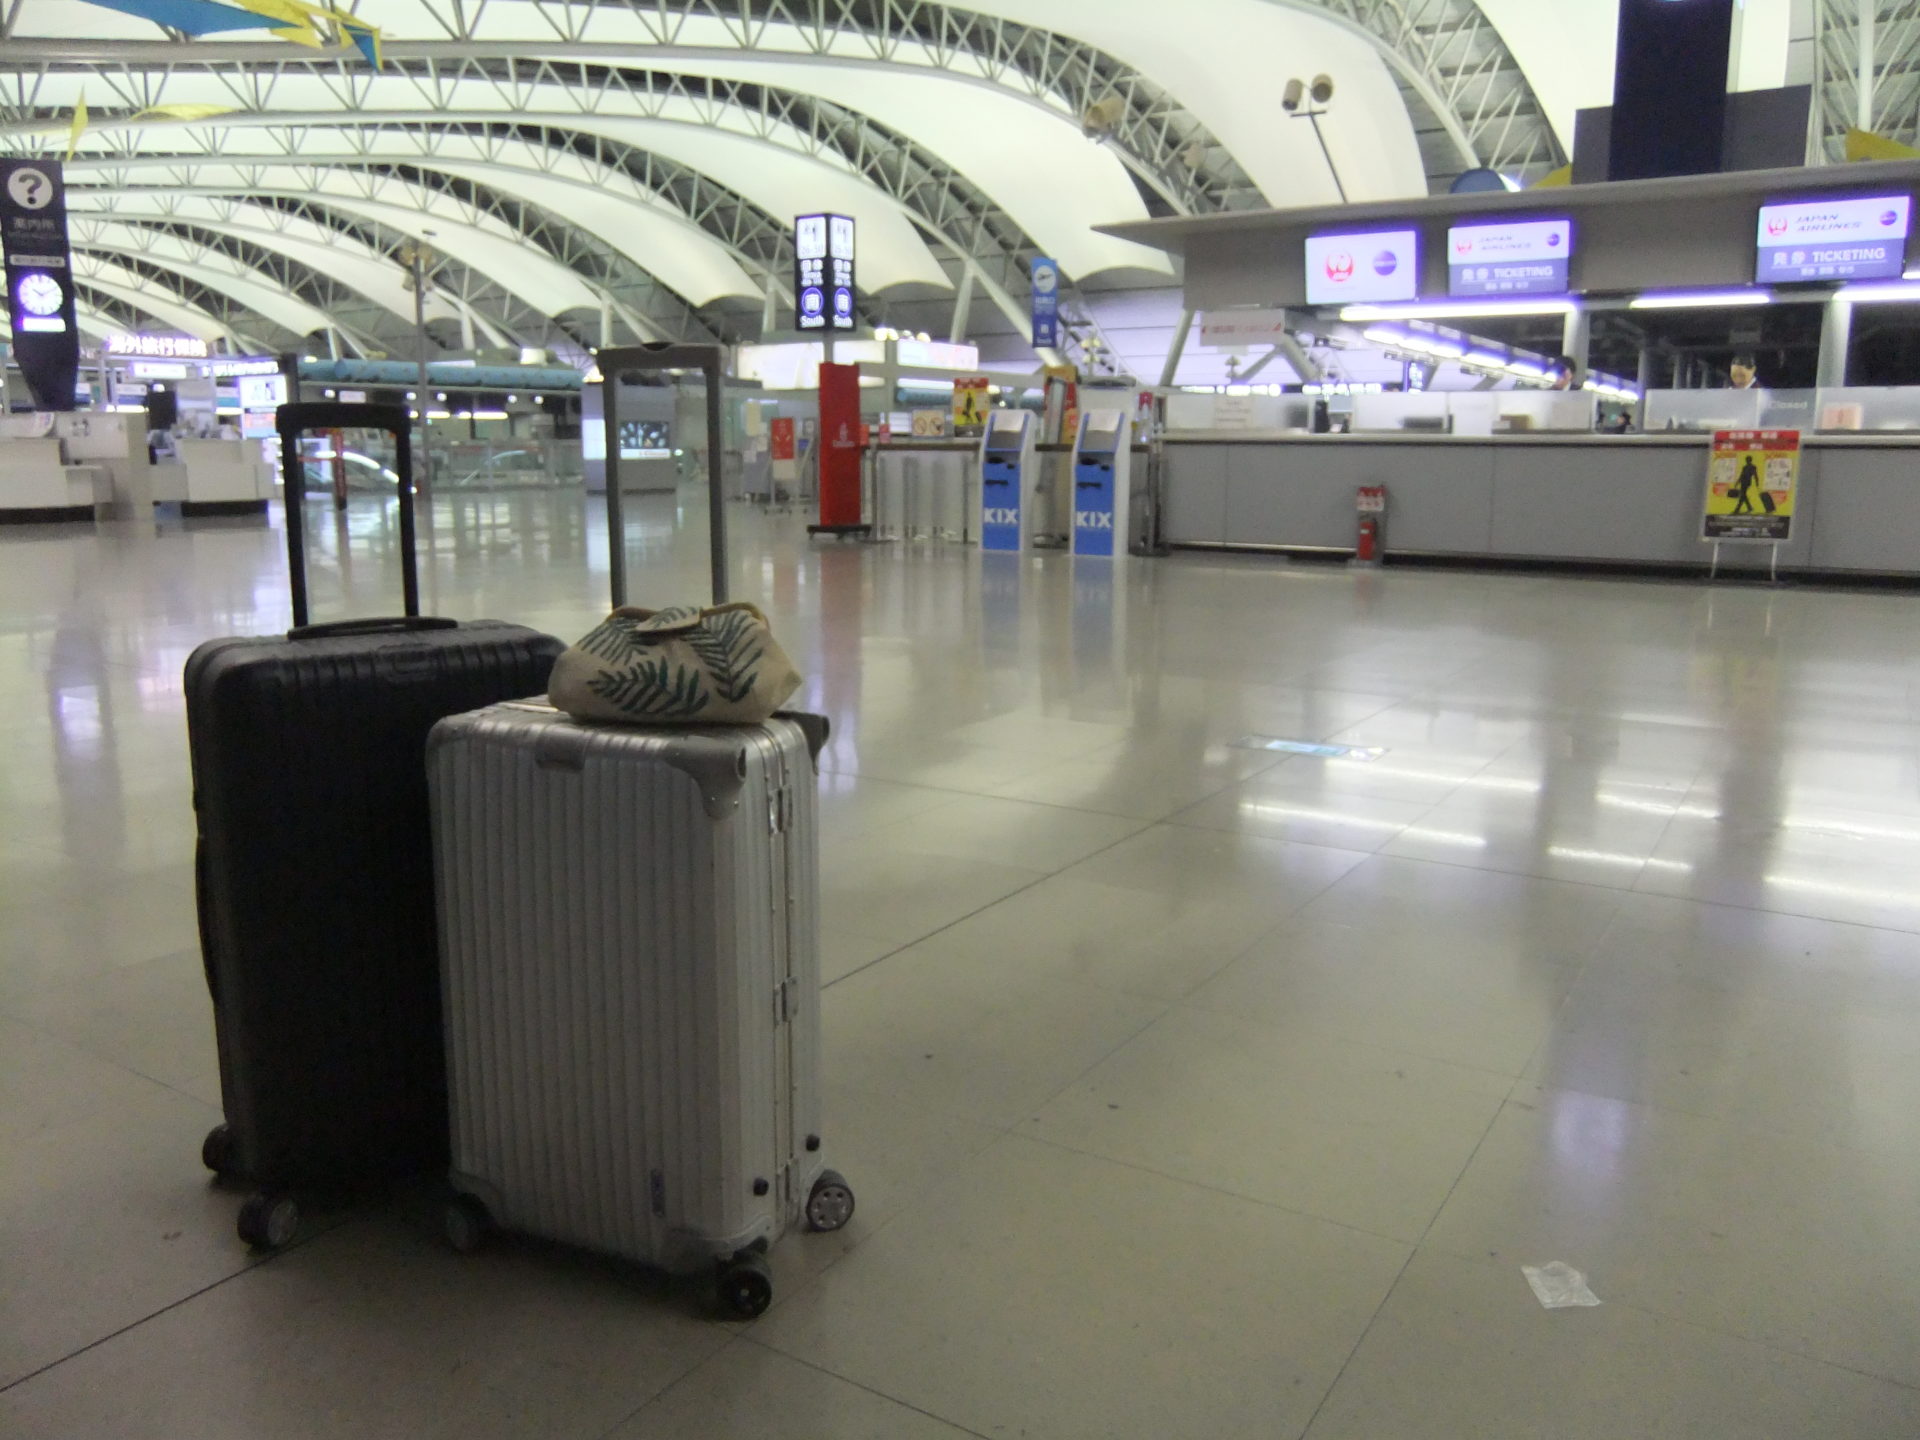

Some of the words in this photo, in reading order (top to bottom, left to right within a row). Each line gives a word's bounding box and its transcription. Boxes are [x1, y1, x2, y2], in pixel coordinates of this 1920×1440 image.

[1812, 247, 1886, 264] TICKETING
[800, 314, 825, 328] South
[833, 314, 853, 328] South
[983, 508, 1019, 524] KIX
[1076, 511, 1112, 528] KIX
